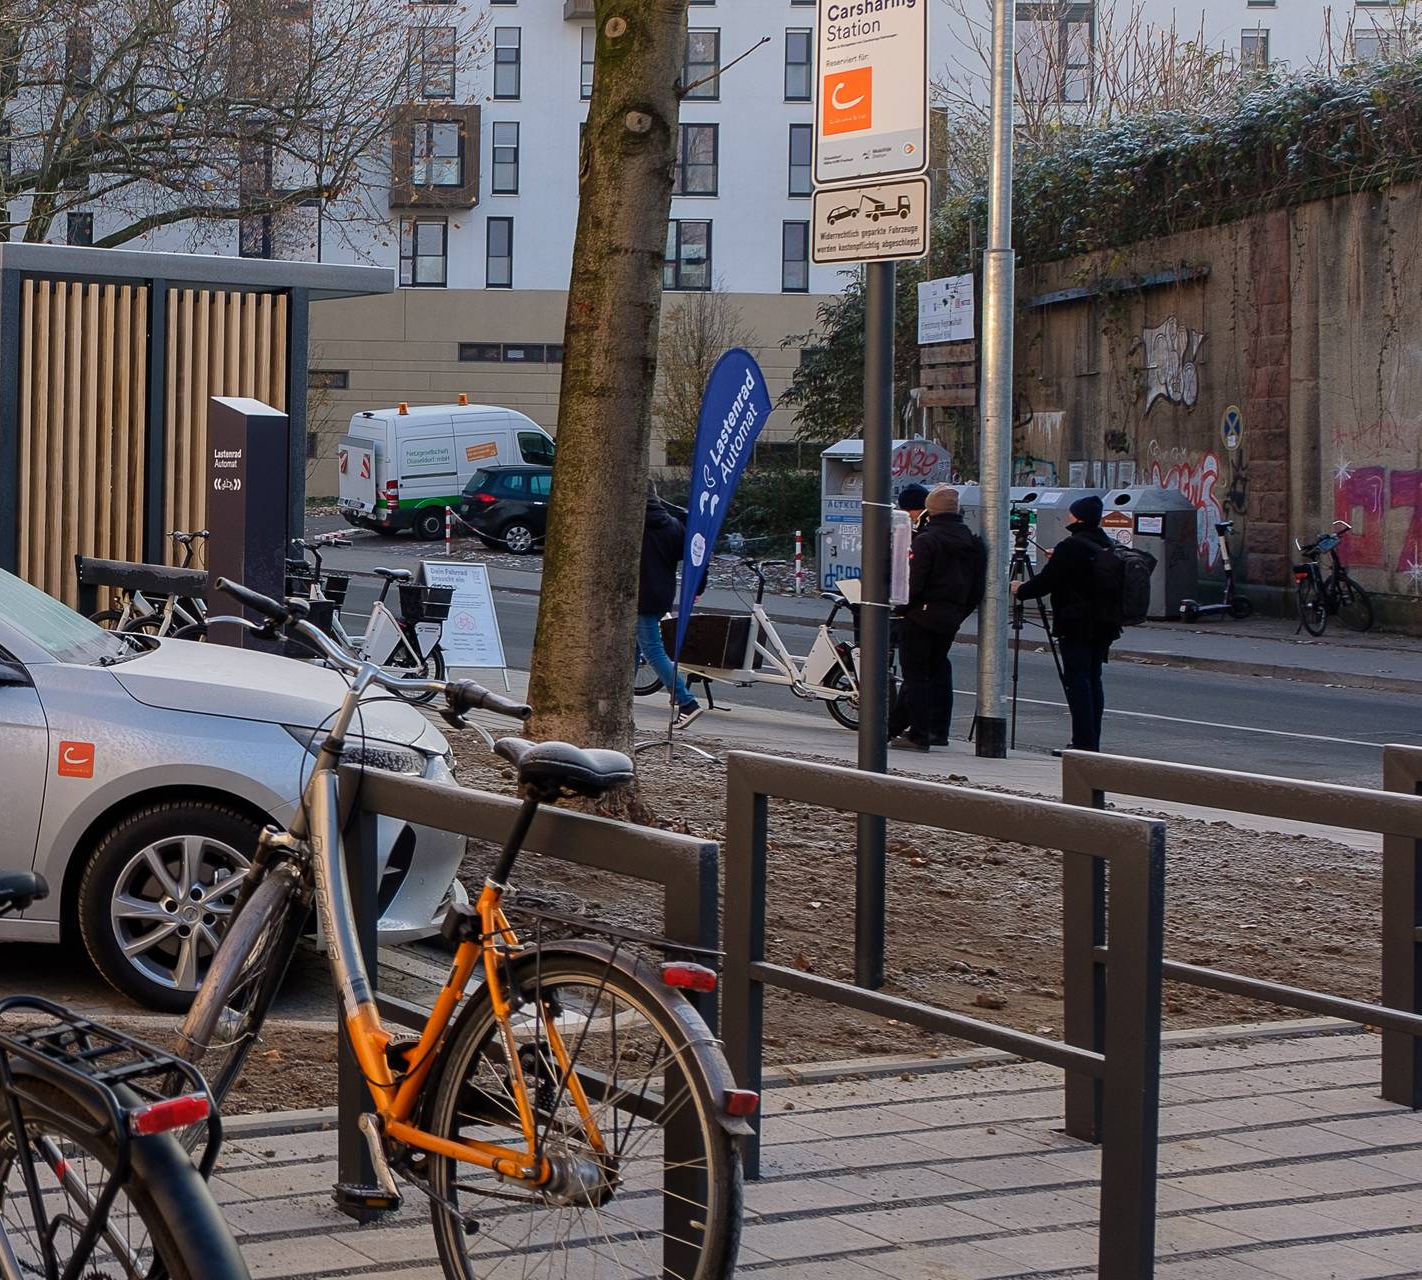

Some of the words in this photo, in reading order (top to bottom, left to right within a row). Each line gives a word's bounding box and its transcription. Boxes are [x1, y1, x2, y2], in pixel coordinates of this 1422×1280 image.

[827, 0, 916, 21] Carsharing
[827, 20, 881, 42] Station
[820, 229, 859, 240] Widerrechtlich
[861, 227, 886, 239] geparkte
[888, 225, 918, 234] Fahrzeuge
[817, 244, 836, 253] werden
[839, 241, 879, 252] kostenpflichtig
[709, 368, 755, 467] Lastenrad
[720, 402, 758, 485] Automat
[214, 449, 242, 458] Lastenrad
[214, 459, 238, 468] Automat
